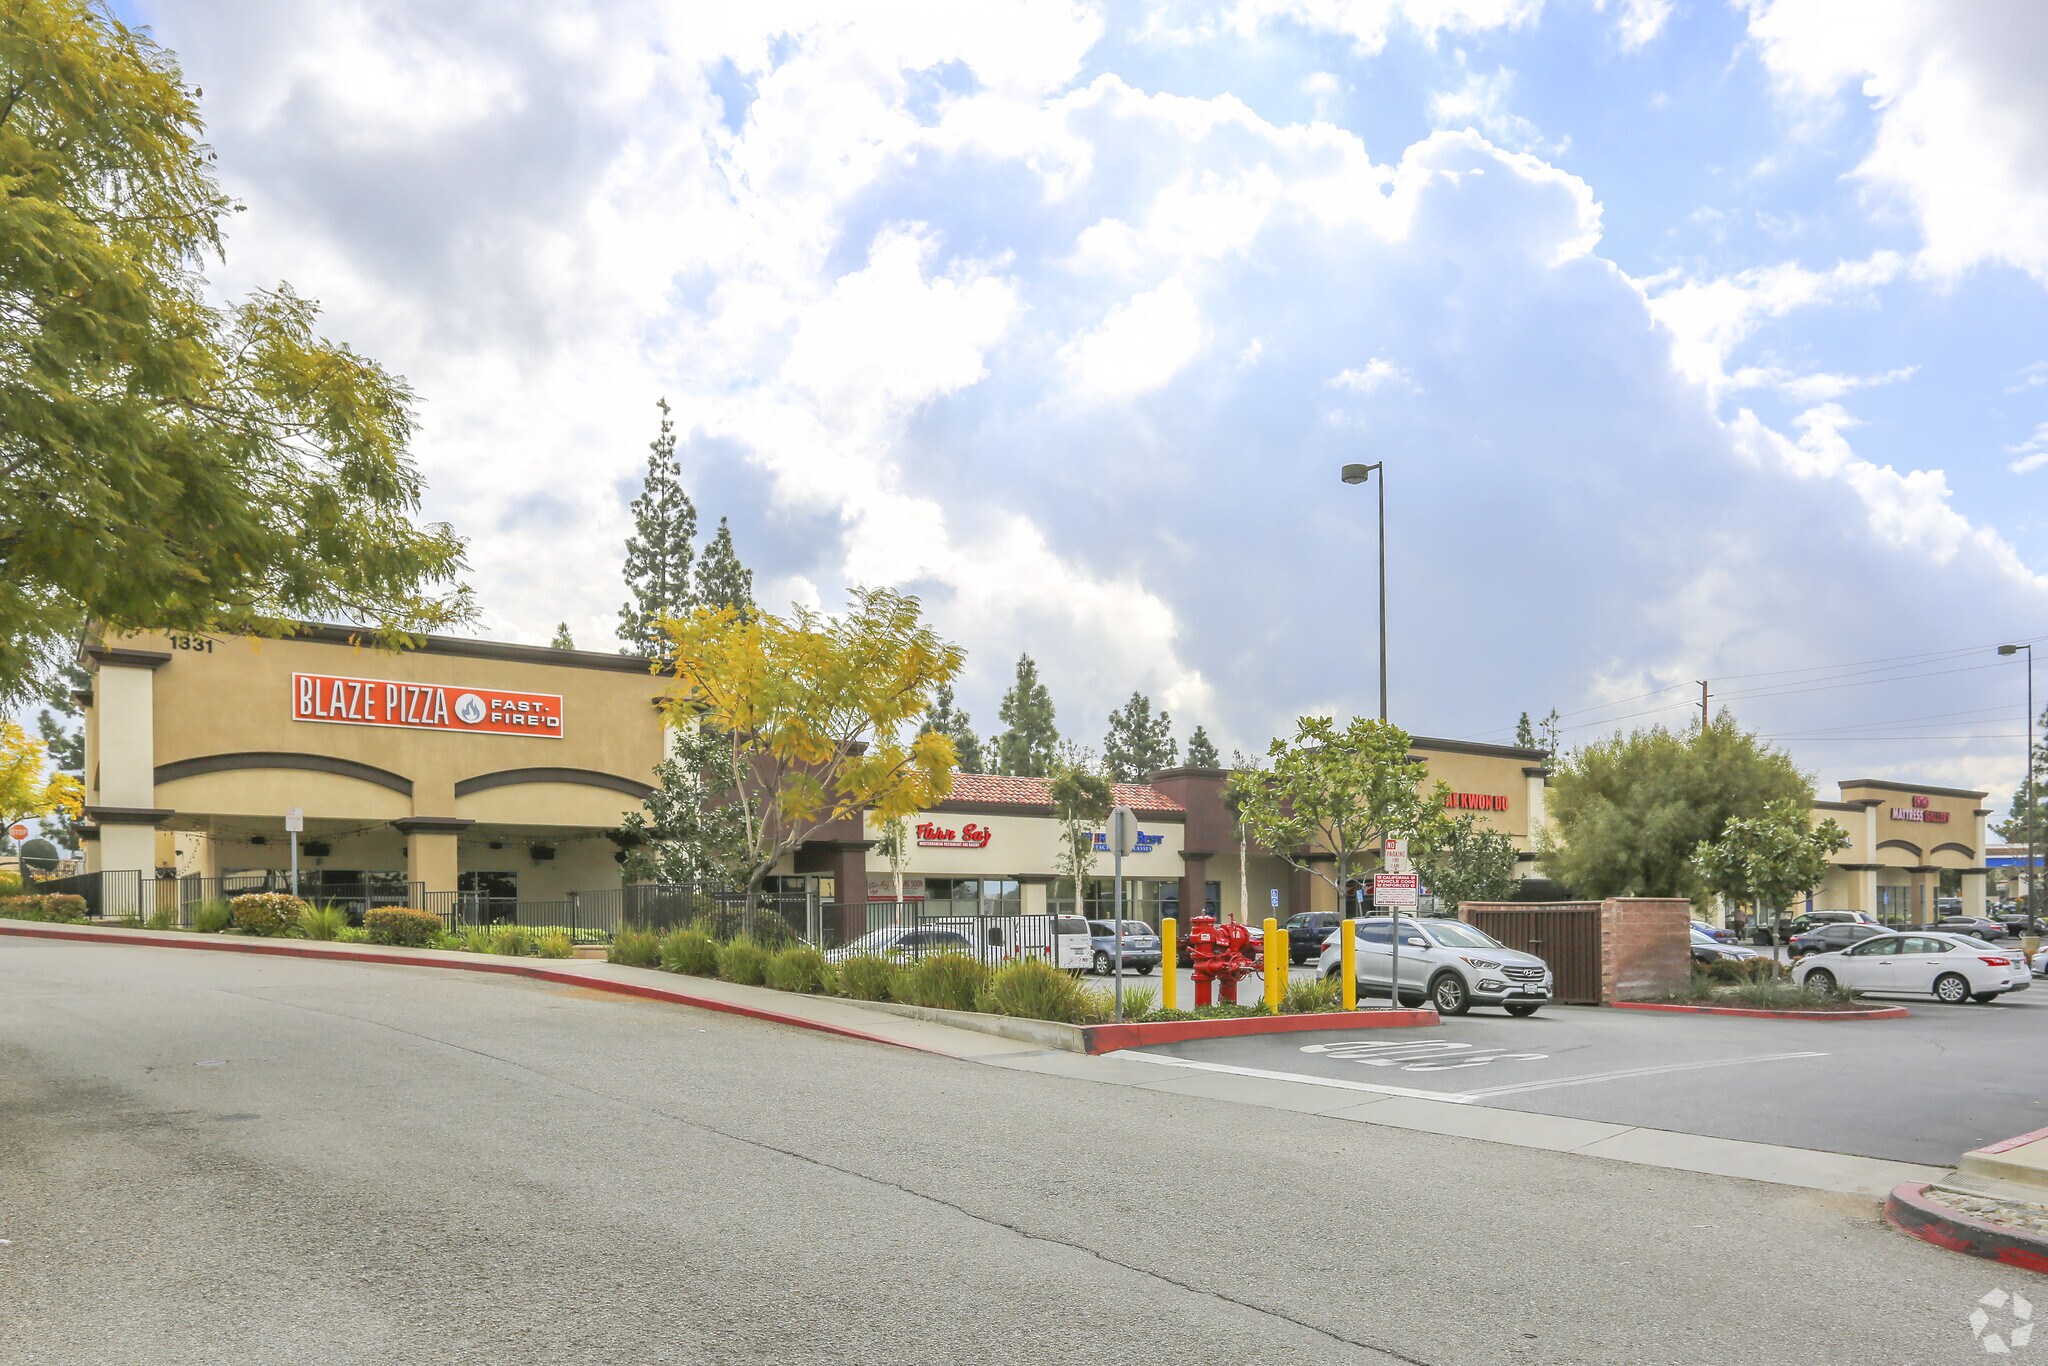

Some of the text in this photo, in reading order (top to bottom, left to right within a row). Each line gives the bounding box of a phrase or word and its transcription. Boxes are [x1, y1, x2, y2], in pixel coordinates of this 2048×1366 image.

[169, 635, 213, 654] 1331
[300, 676, 450, 725] BLAZE PIZZA
[491, 698, 550, 712] FAST-
[491, 713, 560, 727] FIRE'D
[1445, 792, 1509, 811] AE KWON DO
[1891, 808, 1924, 821] MATTRESS
[11, 828, 28, 836] STOP
[962, 823, 992, 849] Saj
[1386, 841, 1395, 849] NO
